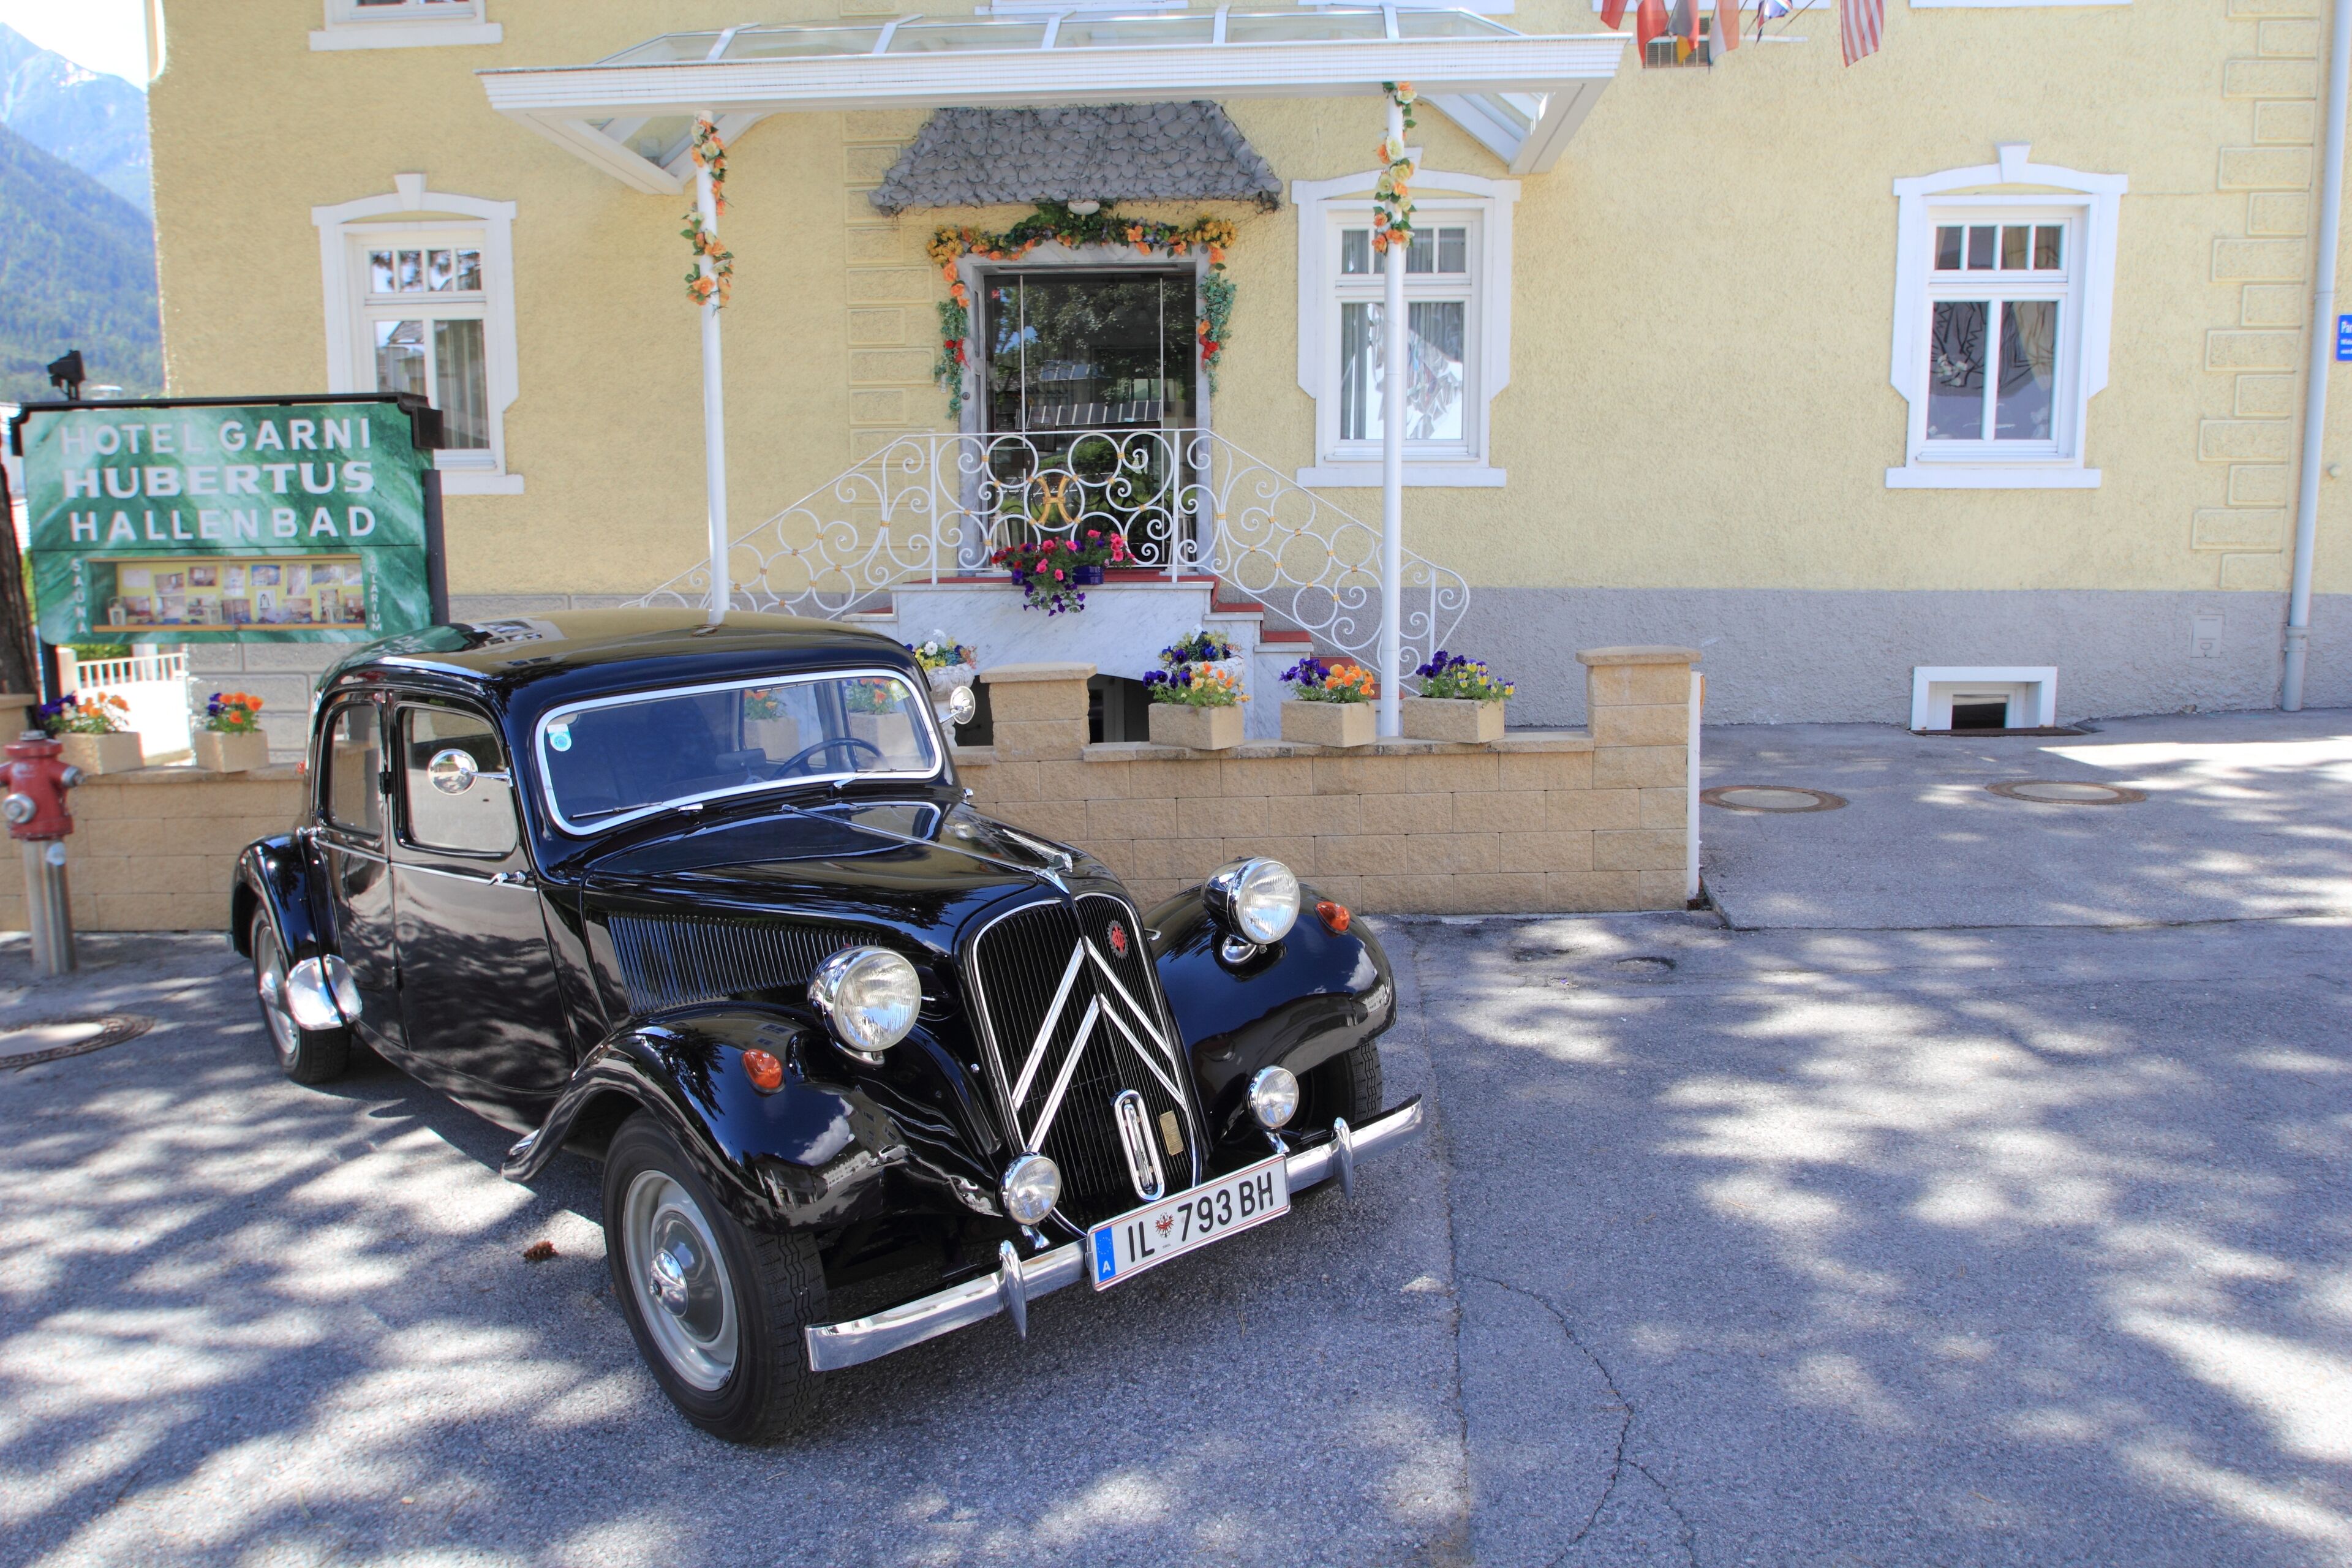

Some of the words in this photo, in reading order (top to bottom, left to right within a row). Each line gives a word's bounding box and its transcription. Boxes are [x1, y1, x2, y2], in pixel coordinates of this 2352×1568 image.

[60, 423, 205, 456] HOTEL
[219, 418, 371, 451] GARNI
[63, 461, 374, 499] HUBERTUS
[69, 505, 376, 542] HALLENBAD
[70, 558, 88, 634] SAUNA
[369, 555, 382, 631] SOLARIUM
[1128, 1221, 1155, 1262] IL
[1177, 1189, 1232, 1242] 793
[1238, 1171, 1274, 1218] BH
[1102, 1260, 1111, 1274] A
